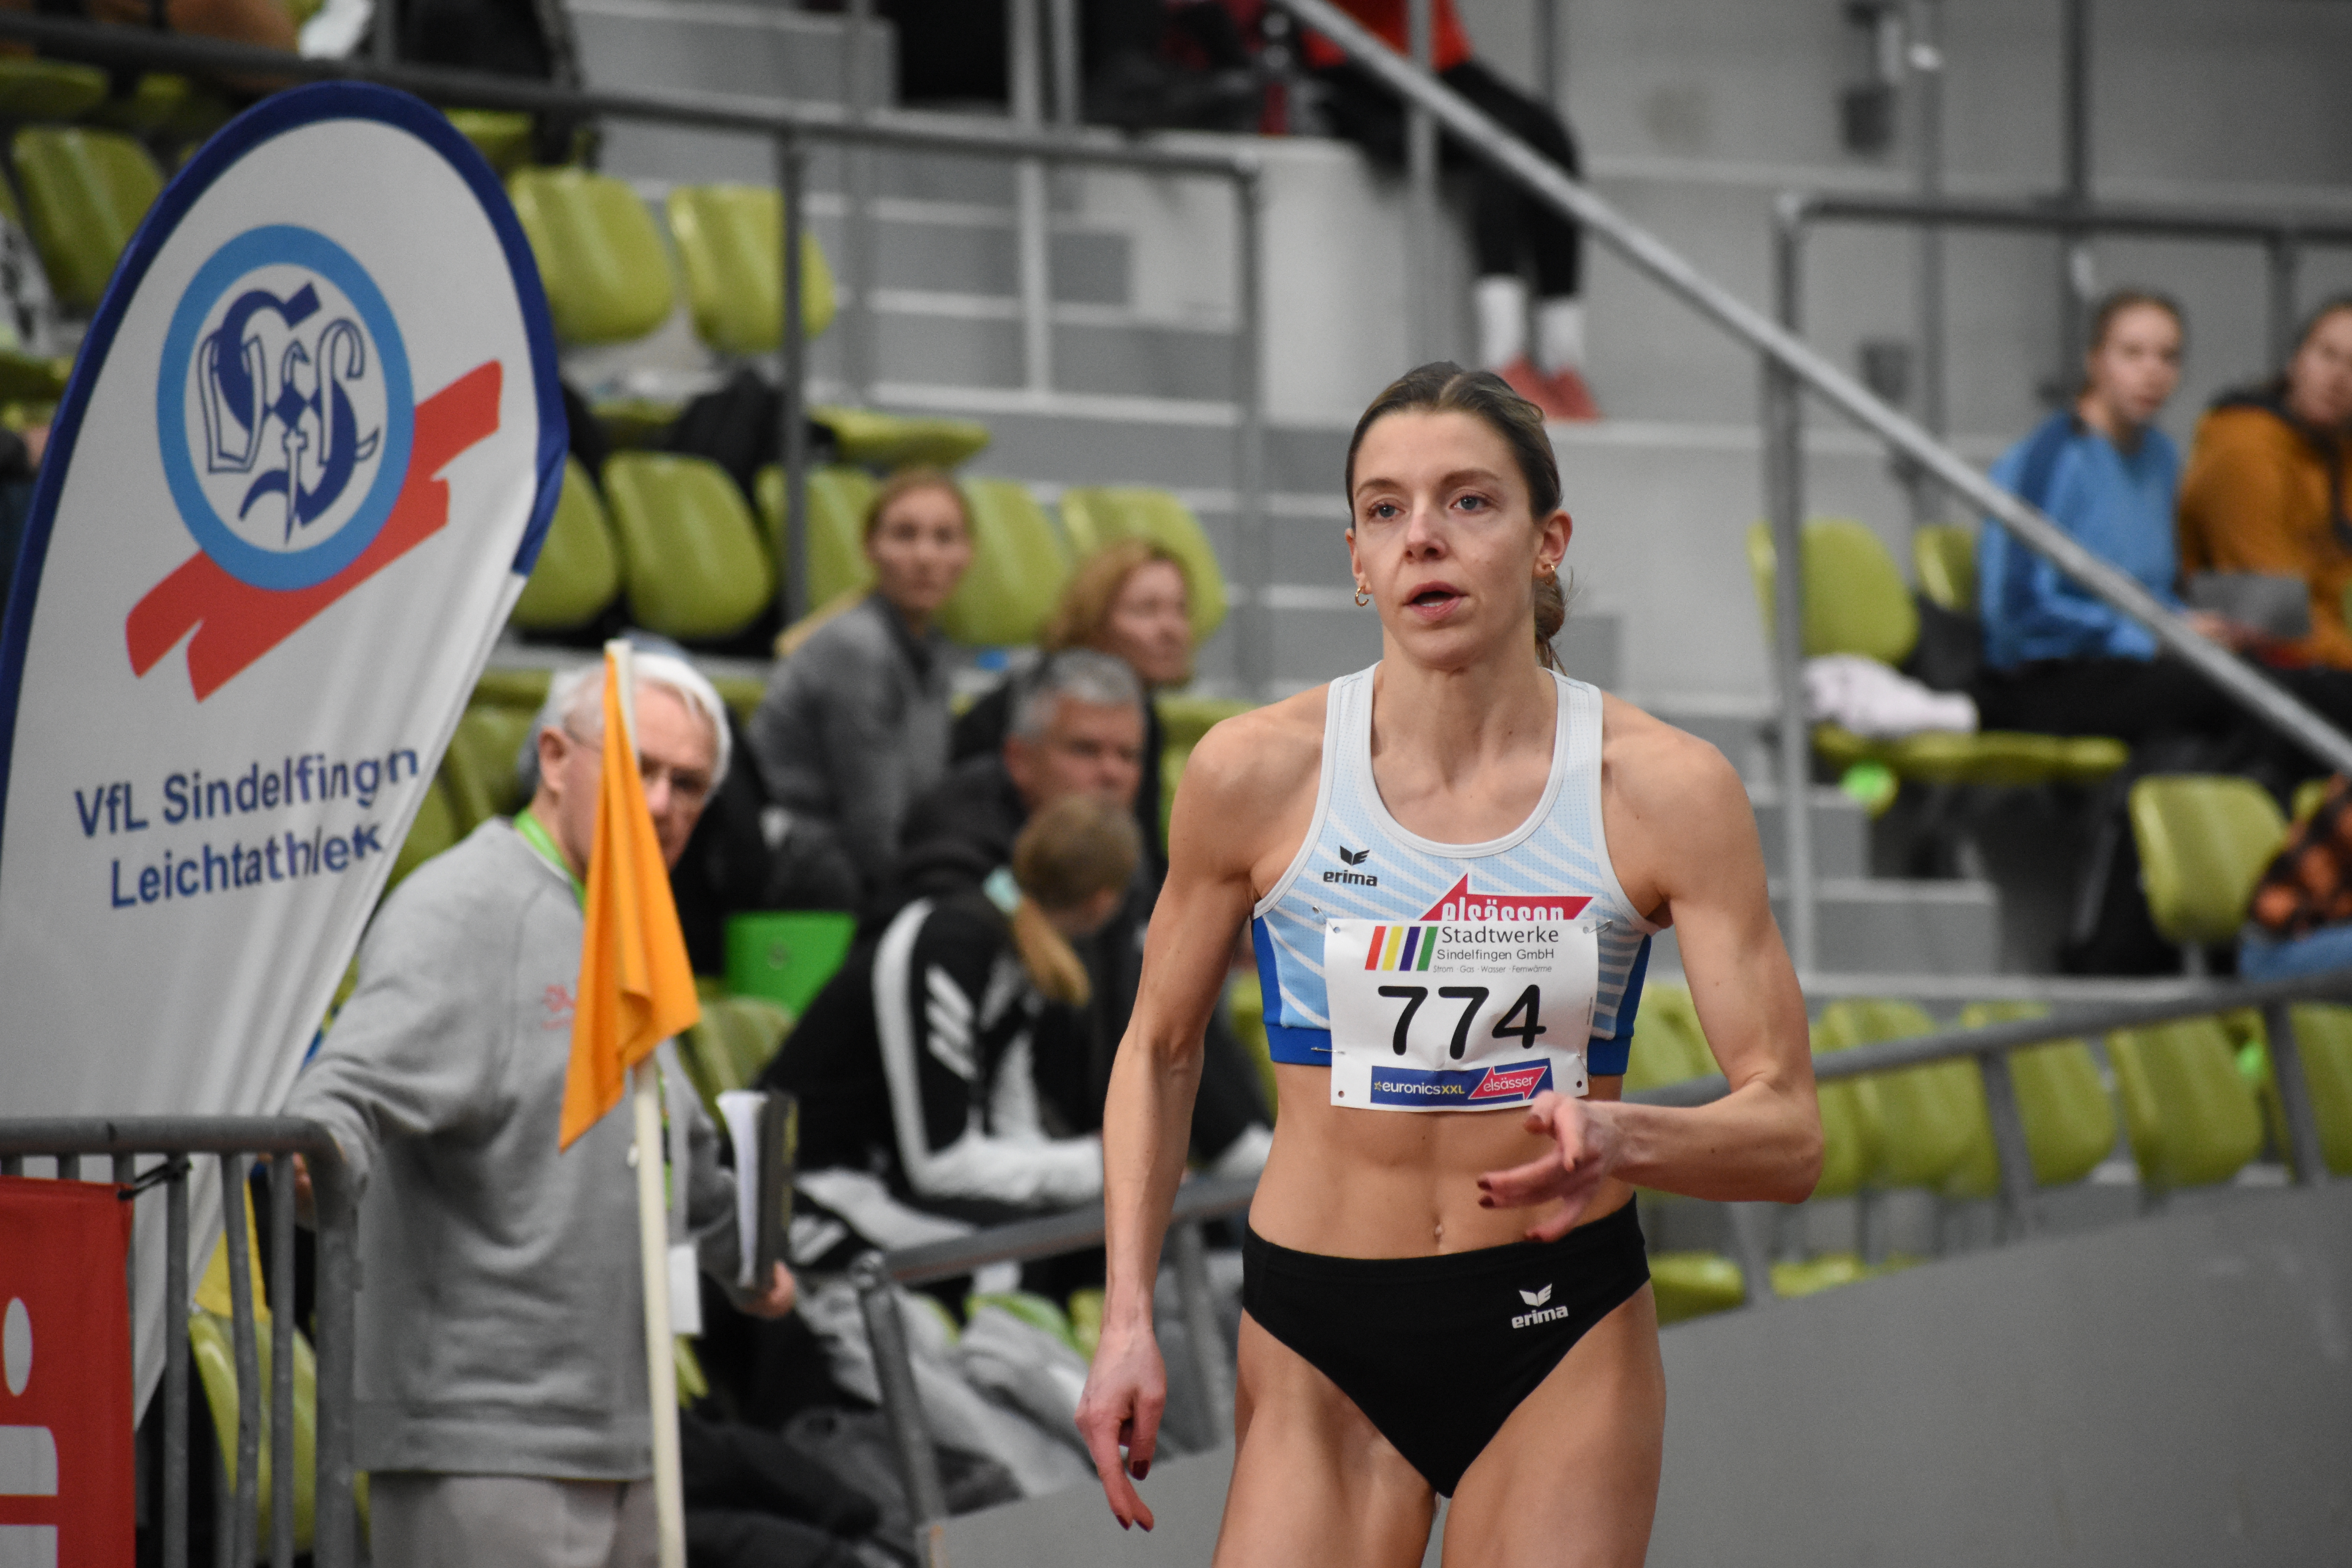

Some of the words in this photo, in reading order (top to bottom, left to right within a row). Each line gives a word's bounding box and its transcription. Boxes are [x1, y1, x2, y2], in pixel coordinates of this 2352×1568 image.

[74, 781, 148, 838] VfL
[163, 748, 419, 825] Sindelfingn
[111, 823, 383, 909] Leichtathlek
[1323, 869, 1377, 887] erima
[1441, 926, 1559, 943] Stadtwerke
[1437, 949, 1512, 962] Sindelfingen
[1516, 948, 1554, 960] GmbH
[1512, 964, 1552, 973] Fernwärme
[1378, 984, 1547, 1060] 774
[1483, 1075, 1534, 1092] elsässer
[1511, 1305, 1569, 1329] erima
